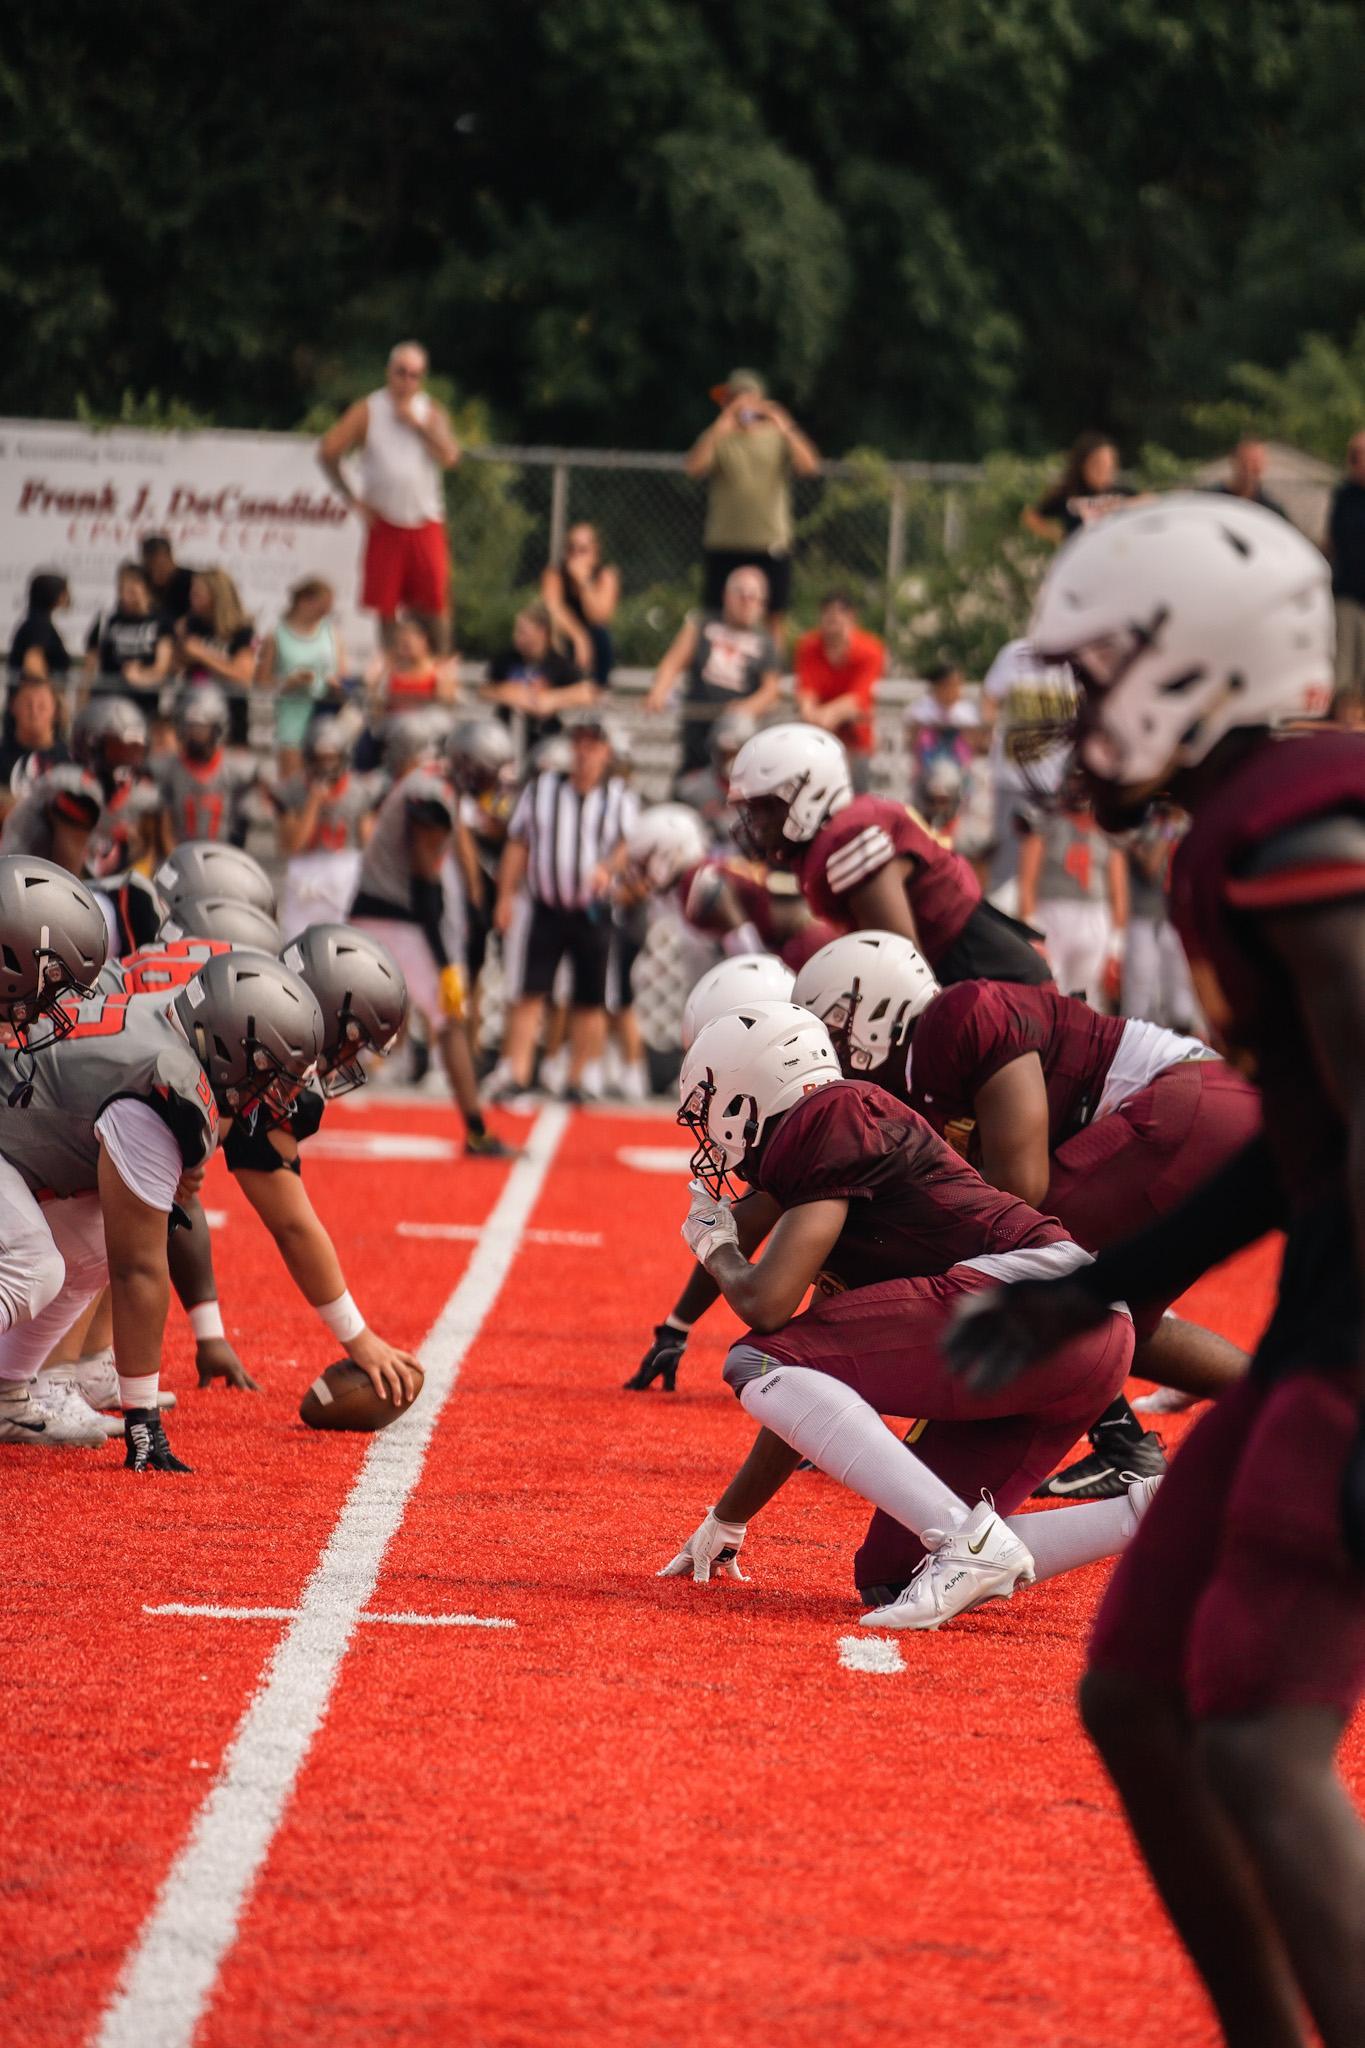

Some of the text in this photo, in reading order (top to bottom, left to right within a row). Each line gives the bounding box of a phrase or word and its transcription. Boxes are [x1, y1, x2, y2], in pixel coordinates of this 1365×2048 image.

[19, 479, 115, 514] Frank
[760, 1375, 781, 1394] NXTRND
[944, 1571, 967, 1592] ALPHA
